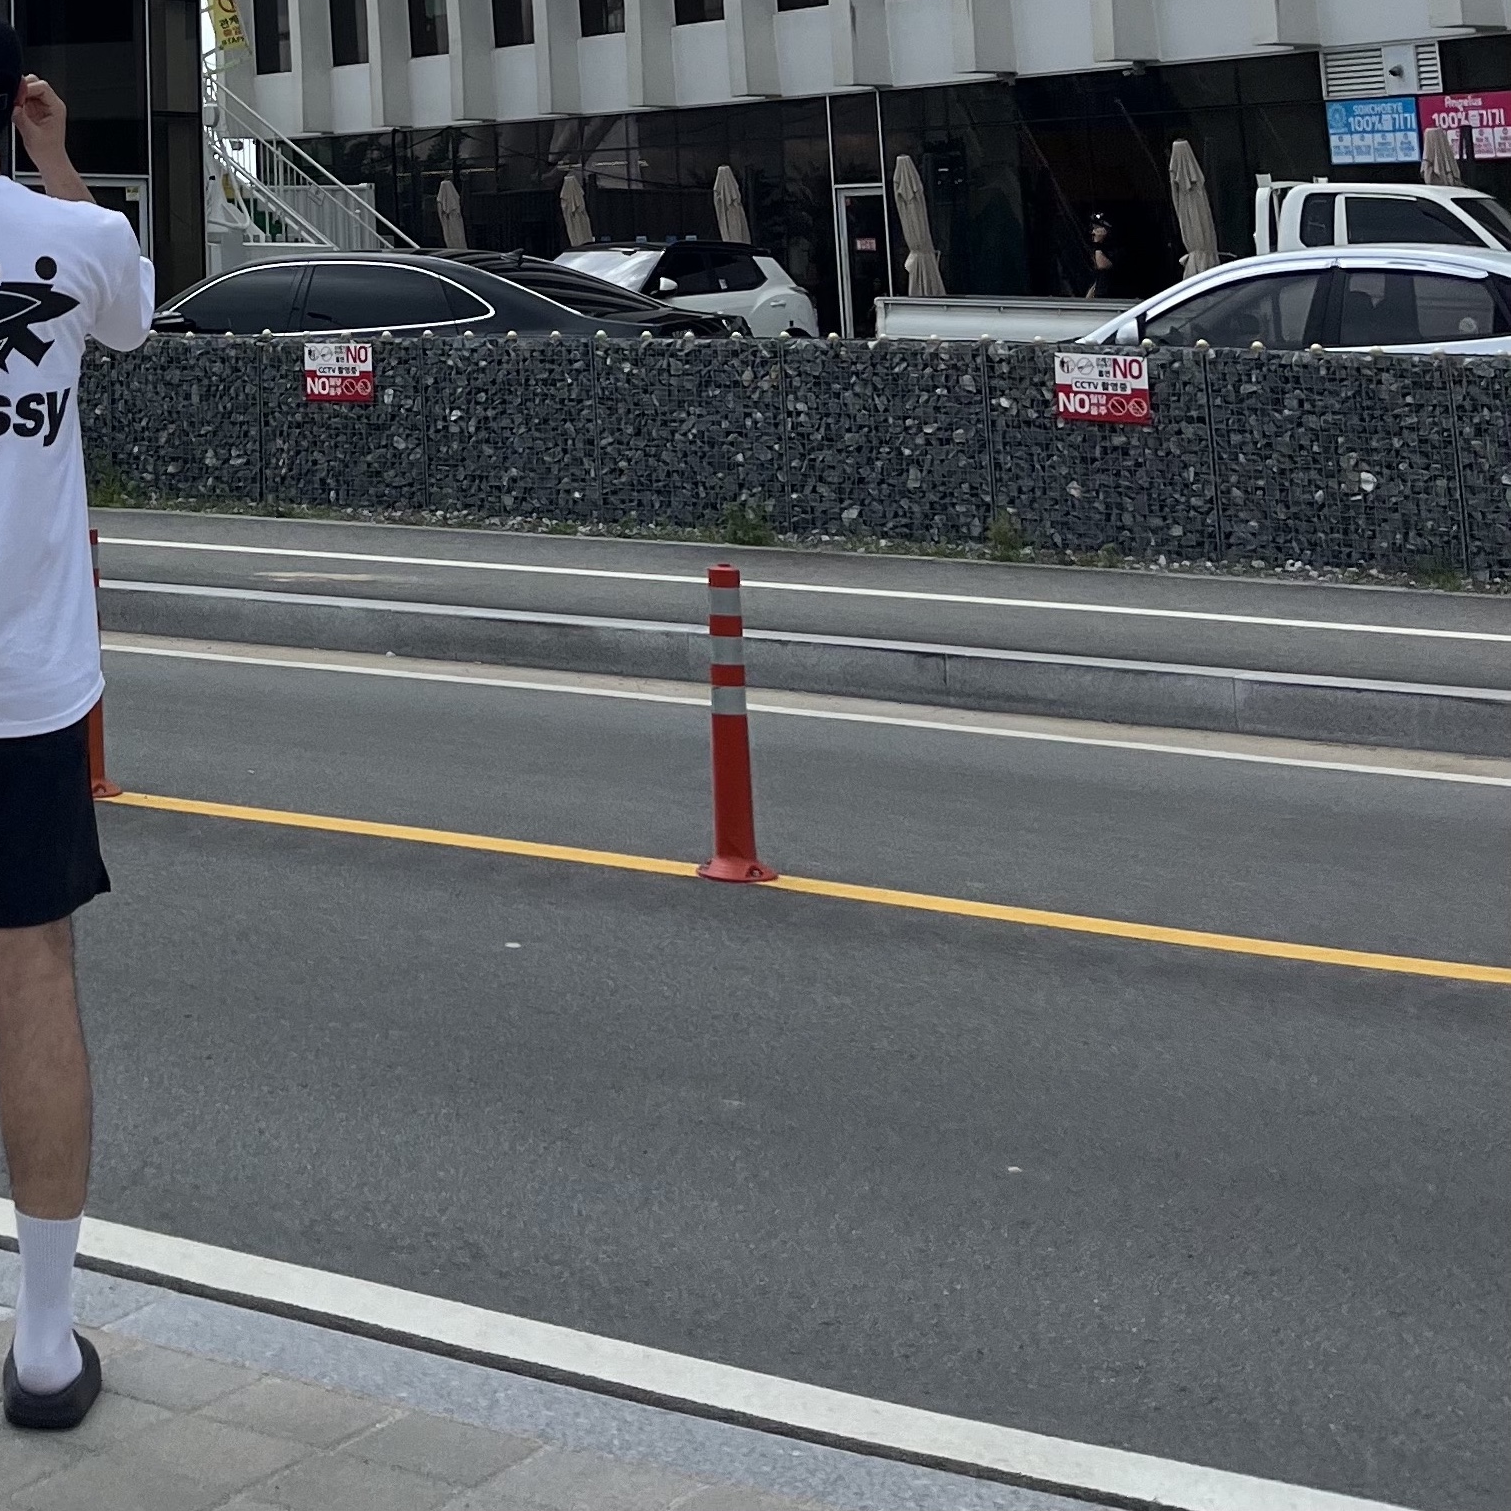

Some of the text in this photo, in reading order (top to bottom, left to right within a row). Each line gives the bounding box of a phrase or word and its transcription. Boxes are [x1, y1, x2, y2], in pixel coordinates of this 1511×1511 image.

[346, 345, 368, 364] NO
[318, 366, 336, 374] CCTV
[1112, 358, 1143, 380] NO
[306, 376, 330, 395] NO
[1074, 380, 1098, 390] CCTV
[1058, 391, 1090, 414] NO
